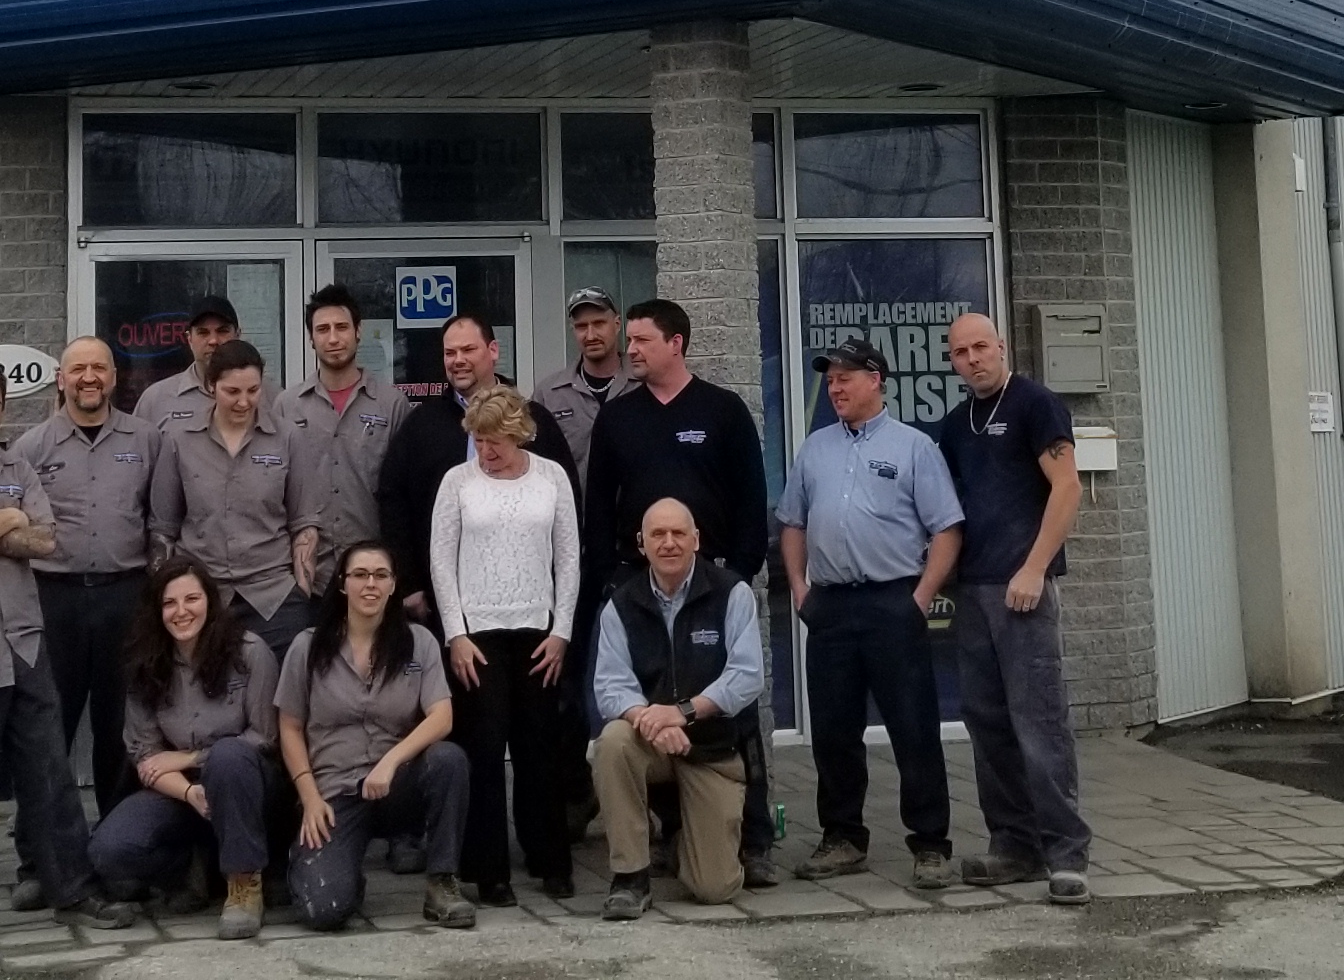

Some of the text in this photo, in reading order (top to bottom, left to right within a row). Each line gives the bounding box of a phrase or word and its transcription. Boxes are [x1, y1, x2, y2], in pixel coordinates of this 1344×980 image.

[401, 275, 452, 313] PPG
[809, 302, 972, 324] REMPLACEMENT
[118, 321, 190, 347] OUVER
[809, 327, 836, 349] DE
[881, 374, 969, 423] RISE
